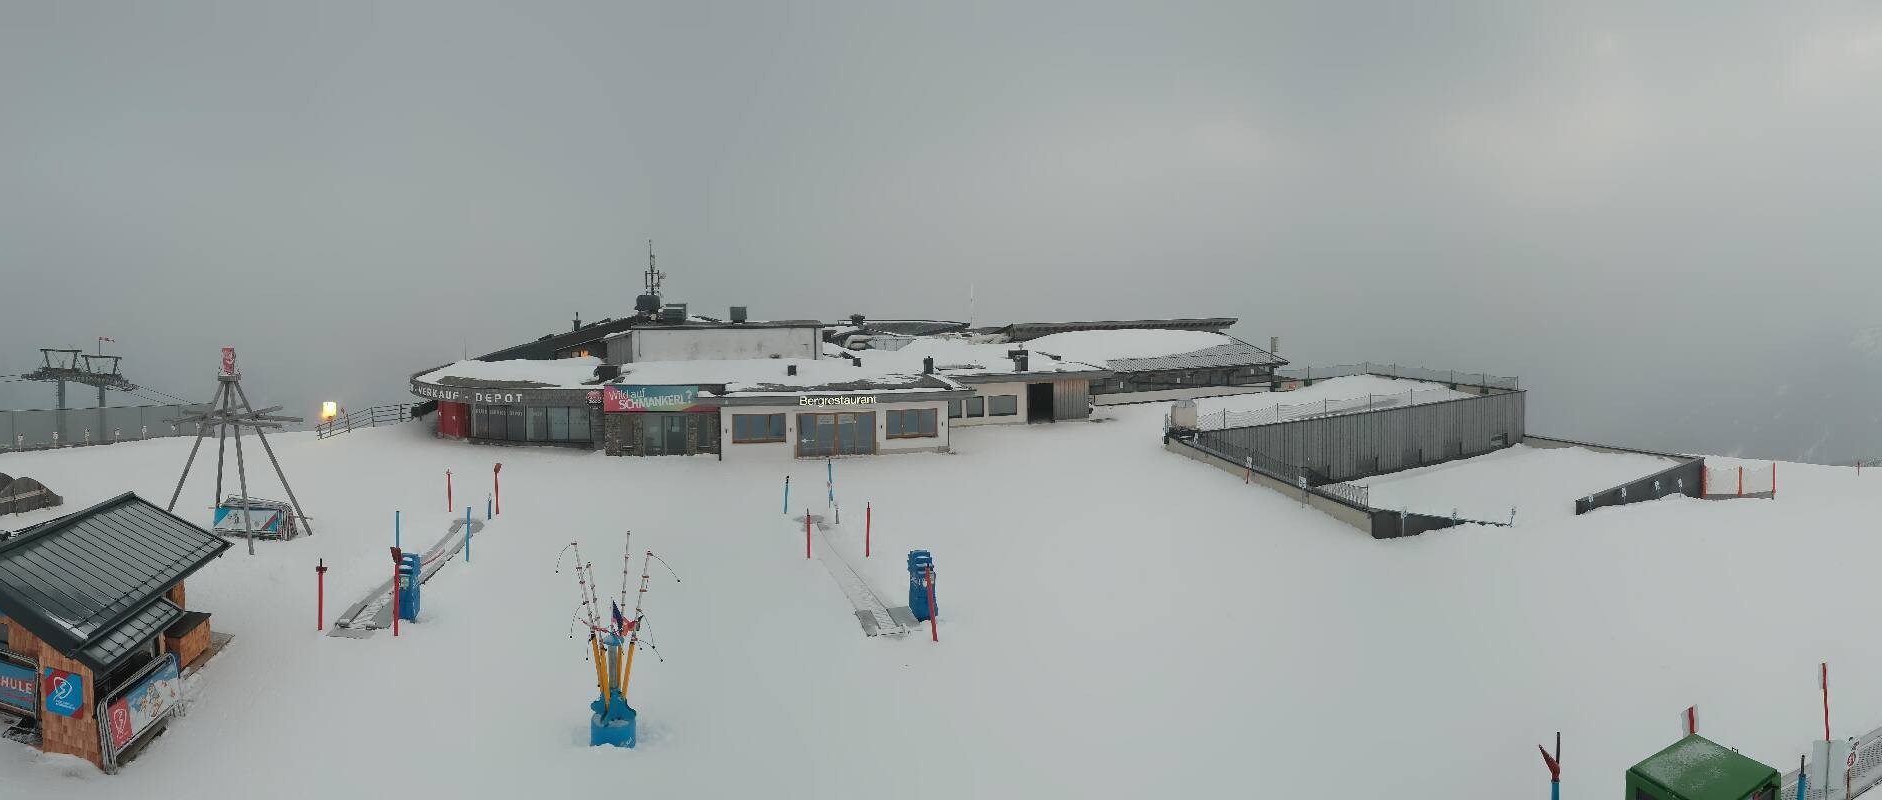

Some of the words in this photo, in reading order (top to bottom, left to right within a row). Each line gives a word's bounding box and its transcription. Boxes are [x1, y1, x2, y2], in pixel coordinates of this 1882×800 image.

[418, 386, 459, 400] VERKAUF
[476, 392, 523, 403] DEPOT
[609, 390, 629, 400] Wild
[631, 388, 646, 398] auf
[799, 395, 877, 407] Bergrestaurant
